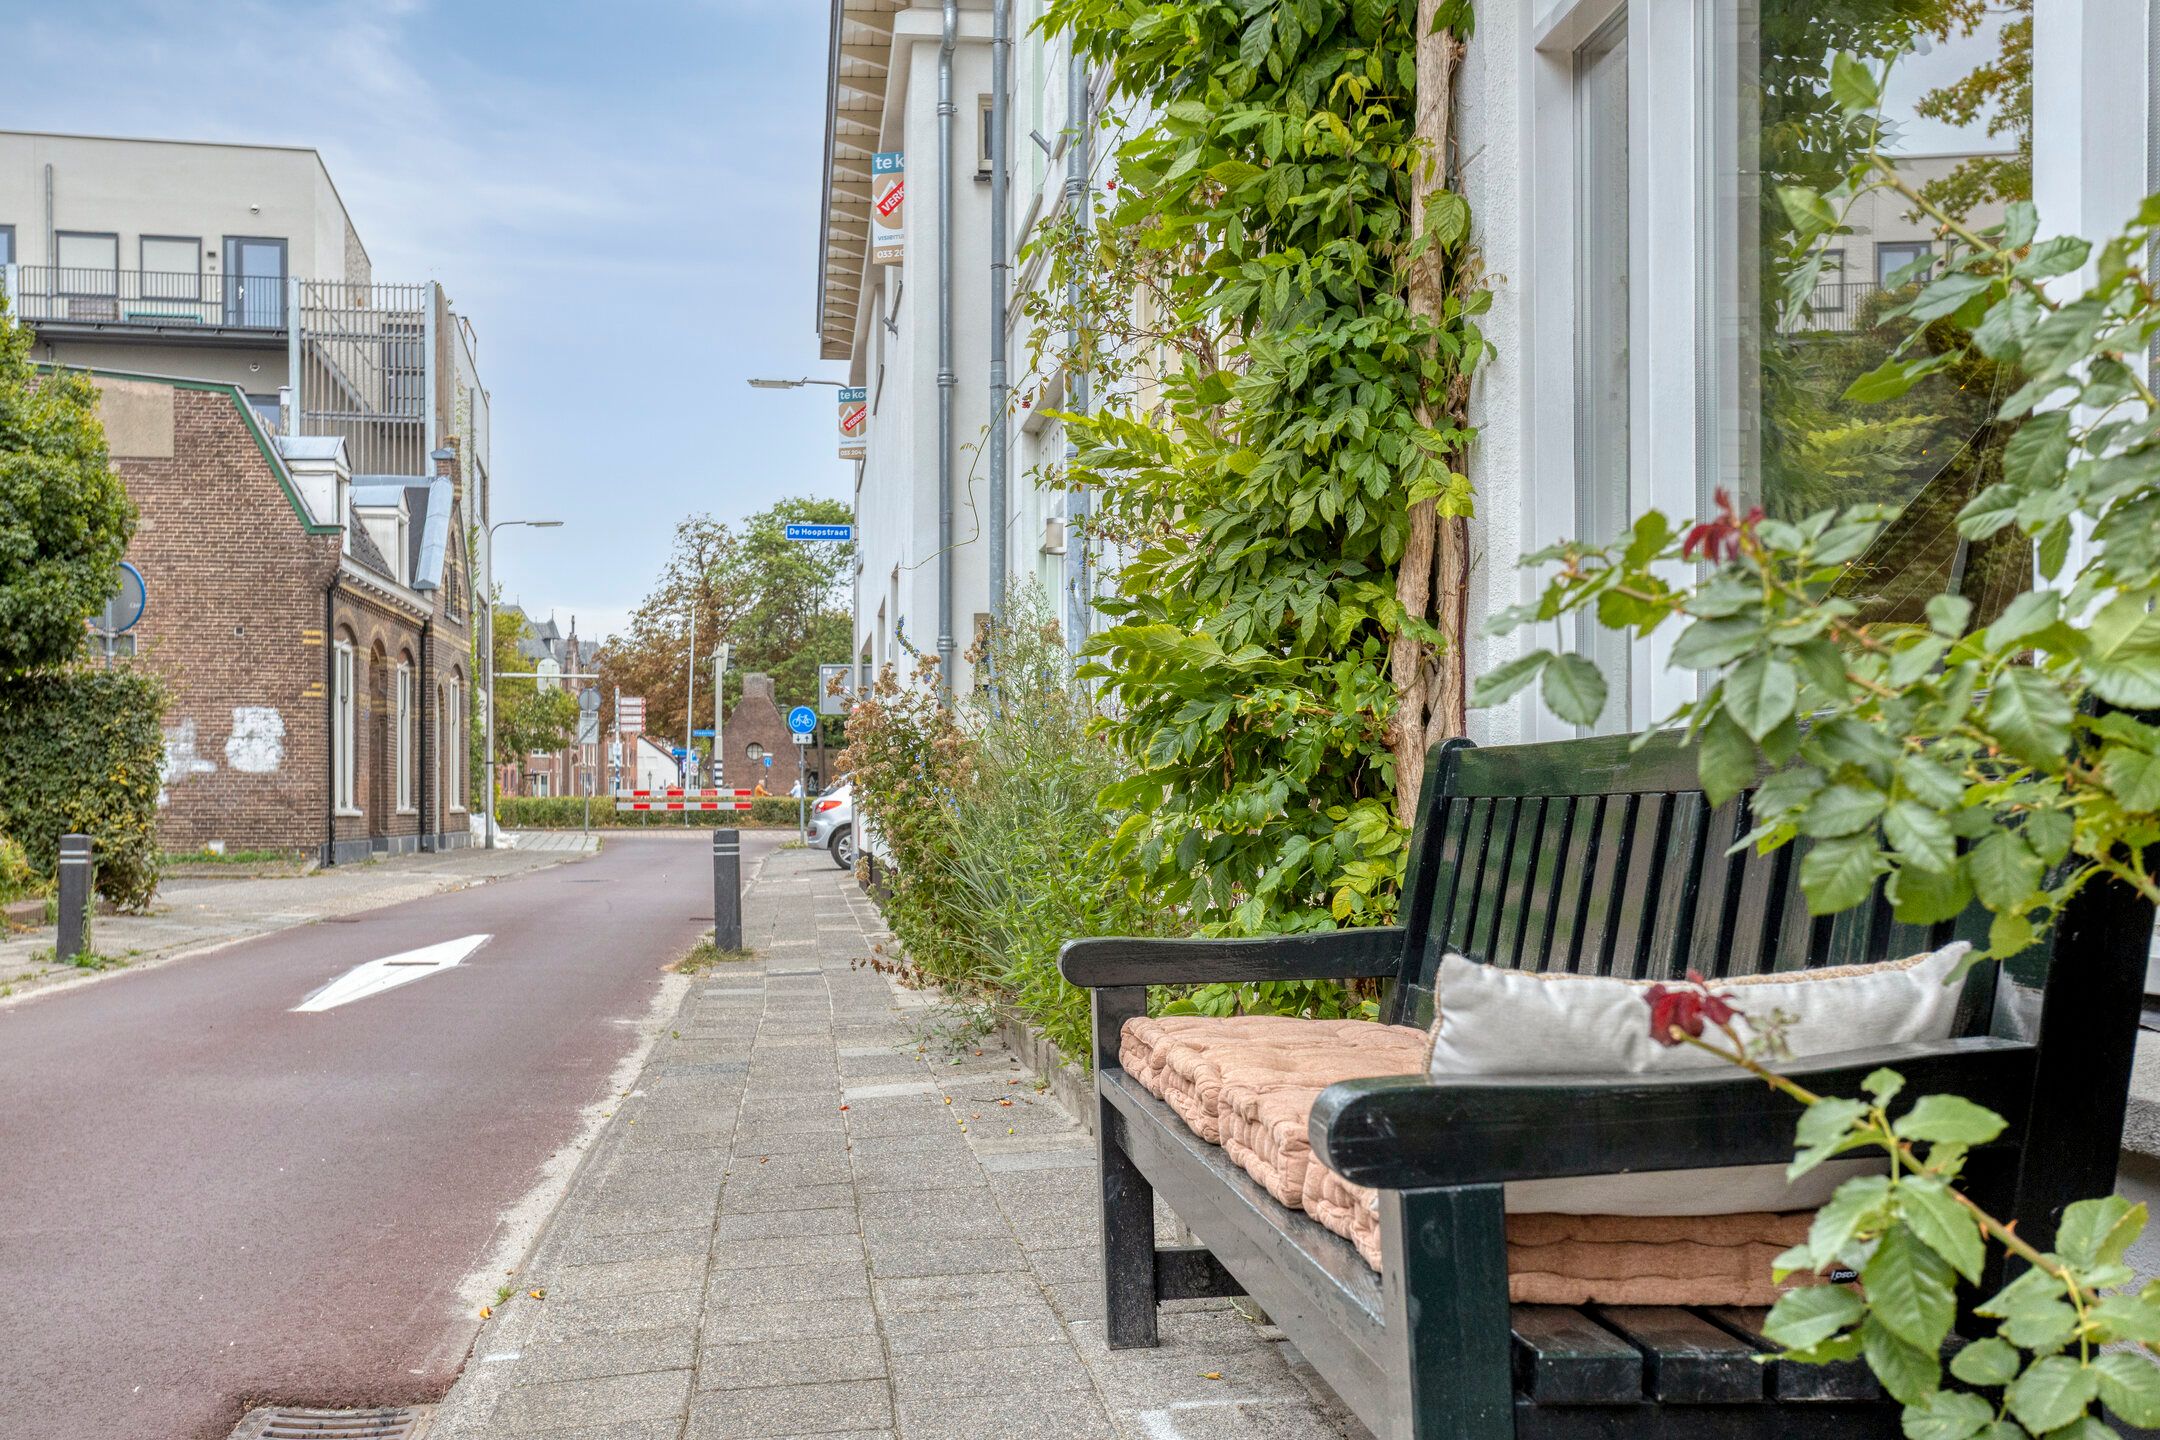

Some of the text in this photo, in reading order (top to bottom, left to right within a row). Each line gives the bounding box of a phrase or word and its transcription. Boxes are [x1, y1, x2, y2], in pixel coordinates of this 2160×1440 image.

[876, 157, 892, 170] te
[877, 250, 893, 258] 033
[840, 391, 850, 400] te
[789, 528, 848, 537] De Hoopstraat
